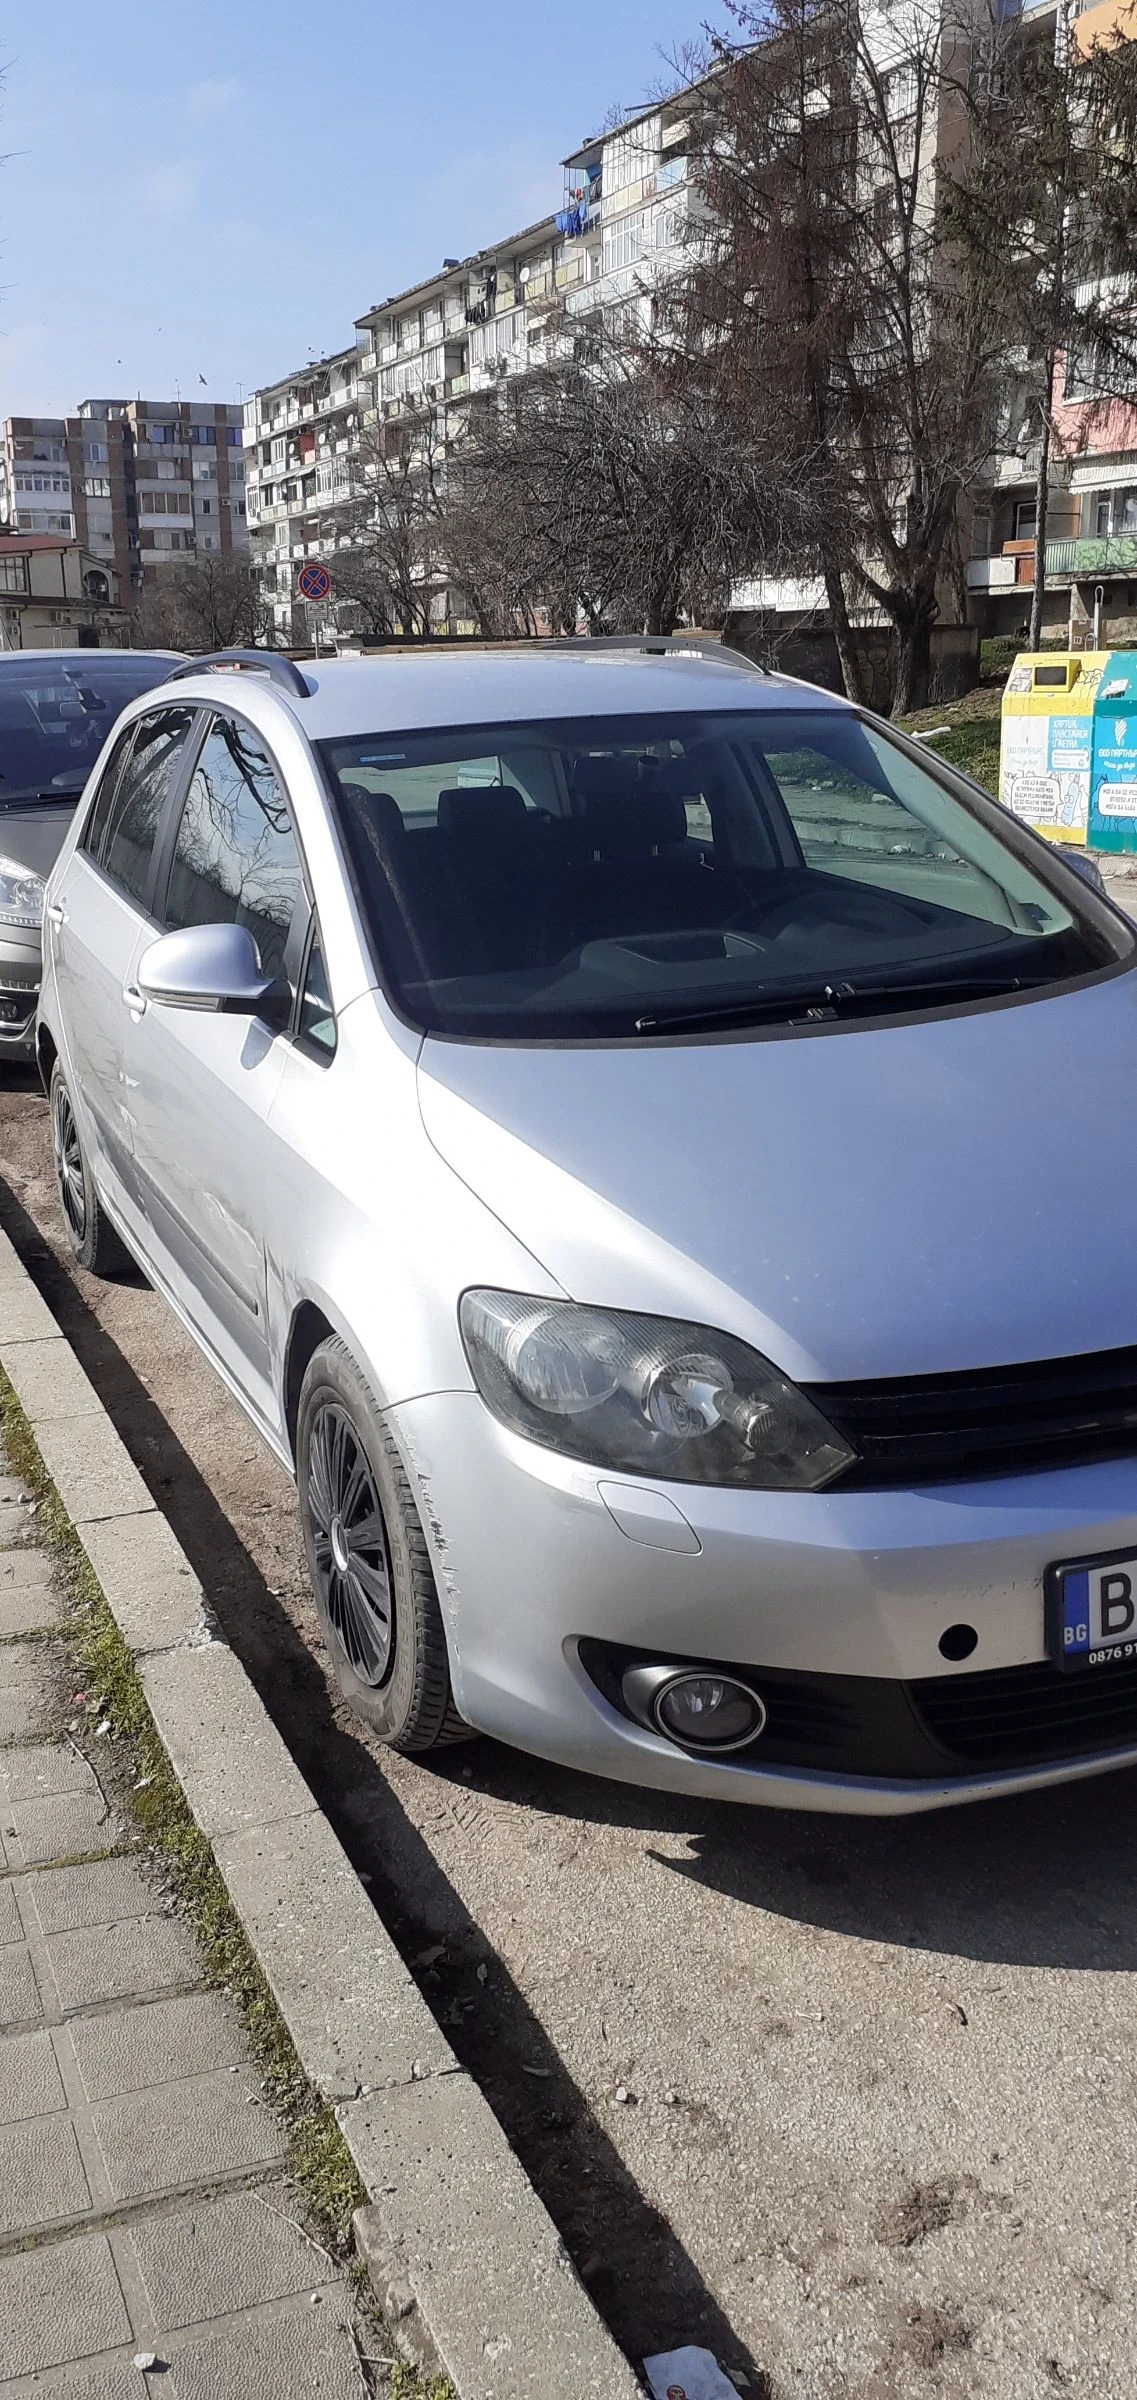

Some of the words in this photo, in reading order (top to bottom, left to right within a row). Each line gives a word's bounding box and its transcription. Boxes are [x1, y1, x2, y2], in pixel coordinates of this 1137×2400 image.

[1100, 1572, 1135, 1637] B
[1064, 1623, 1087, 1645] BG
[1088, 1646, 1122, 1664] 0876
